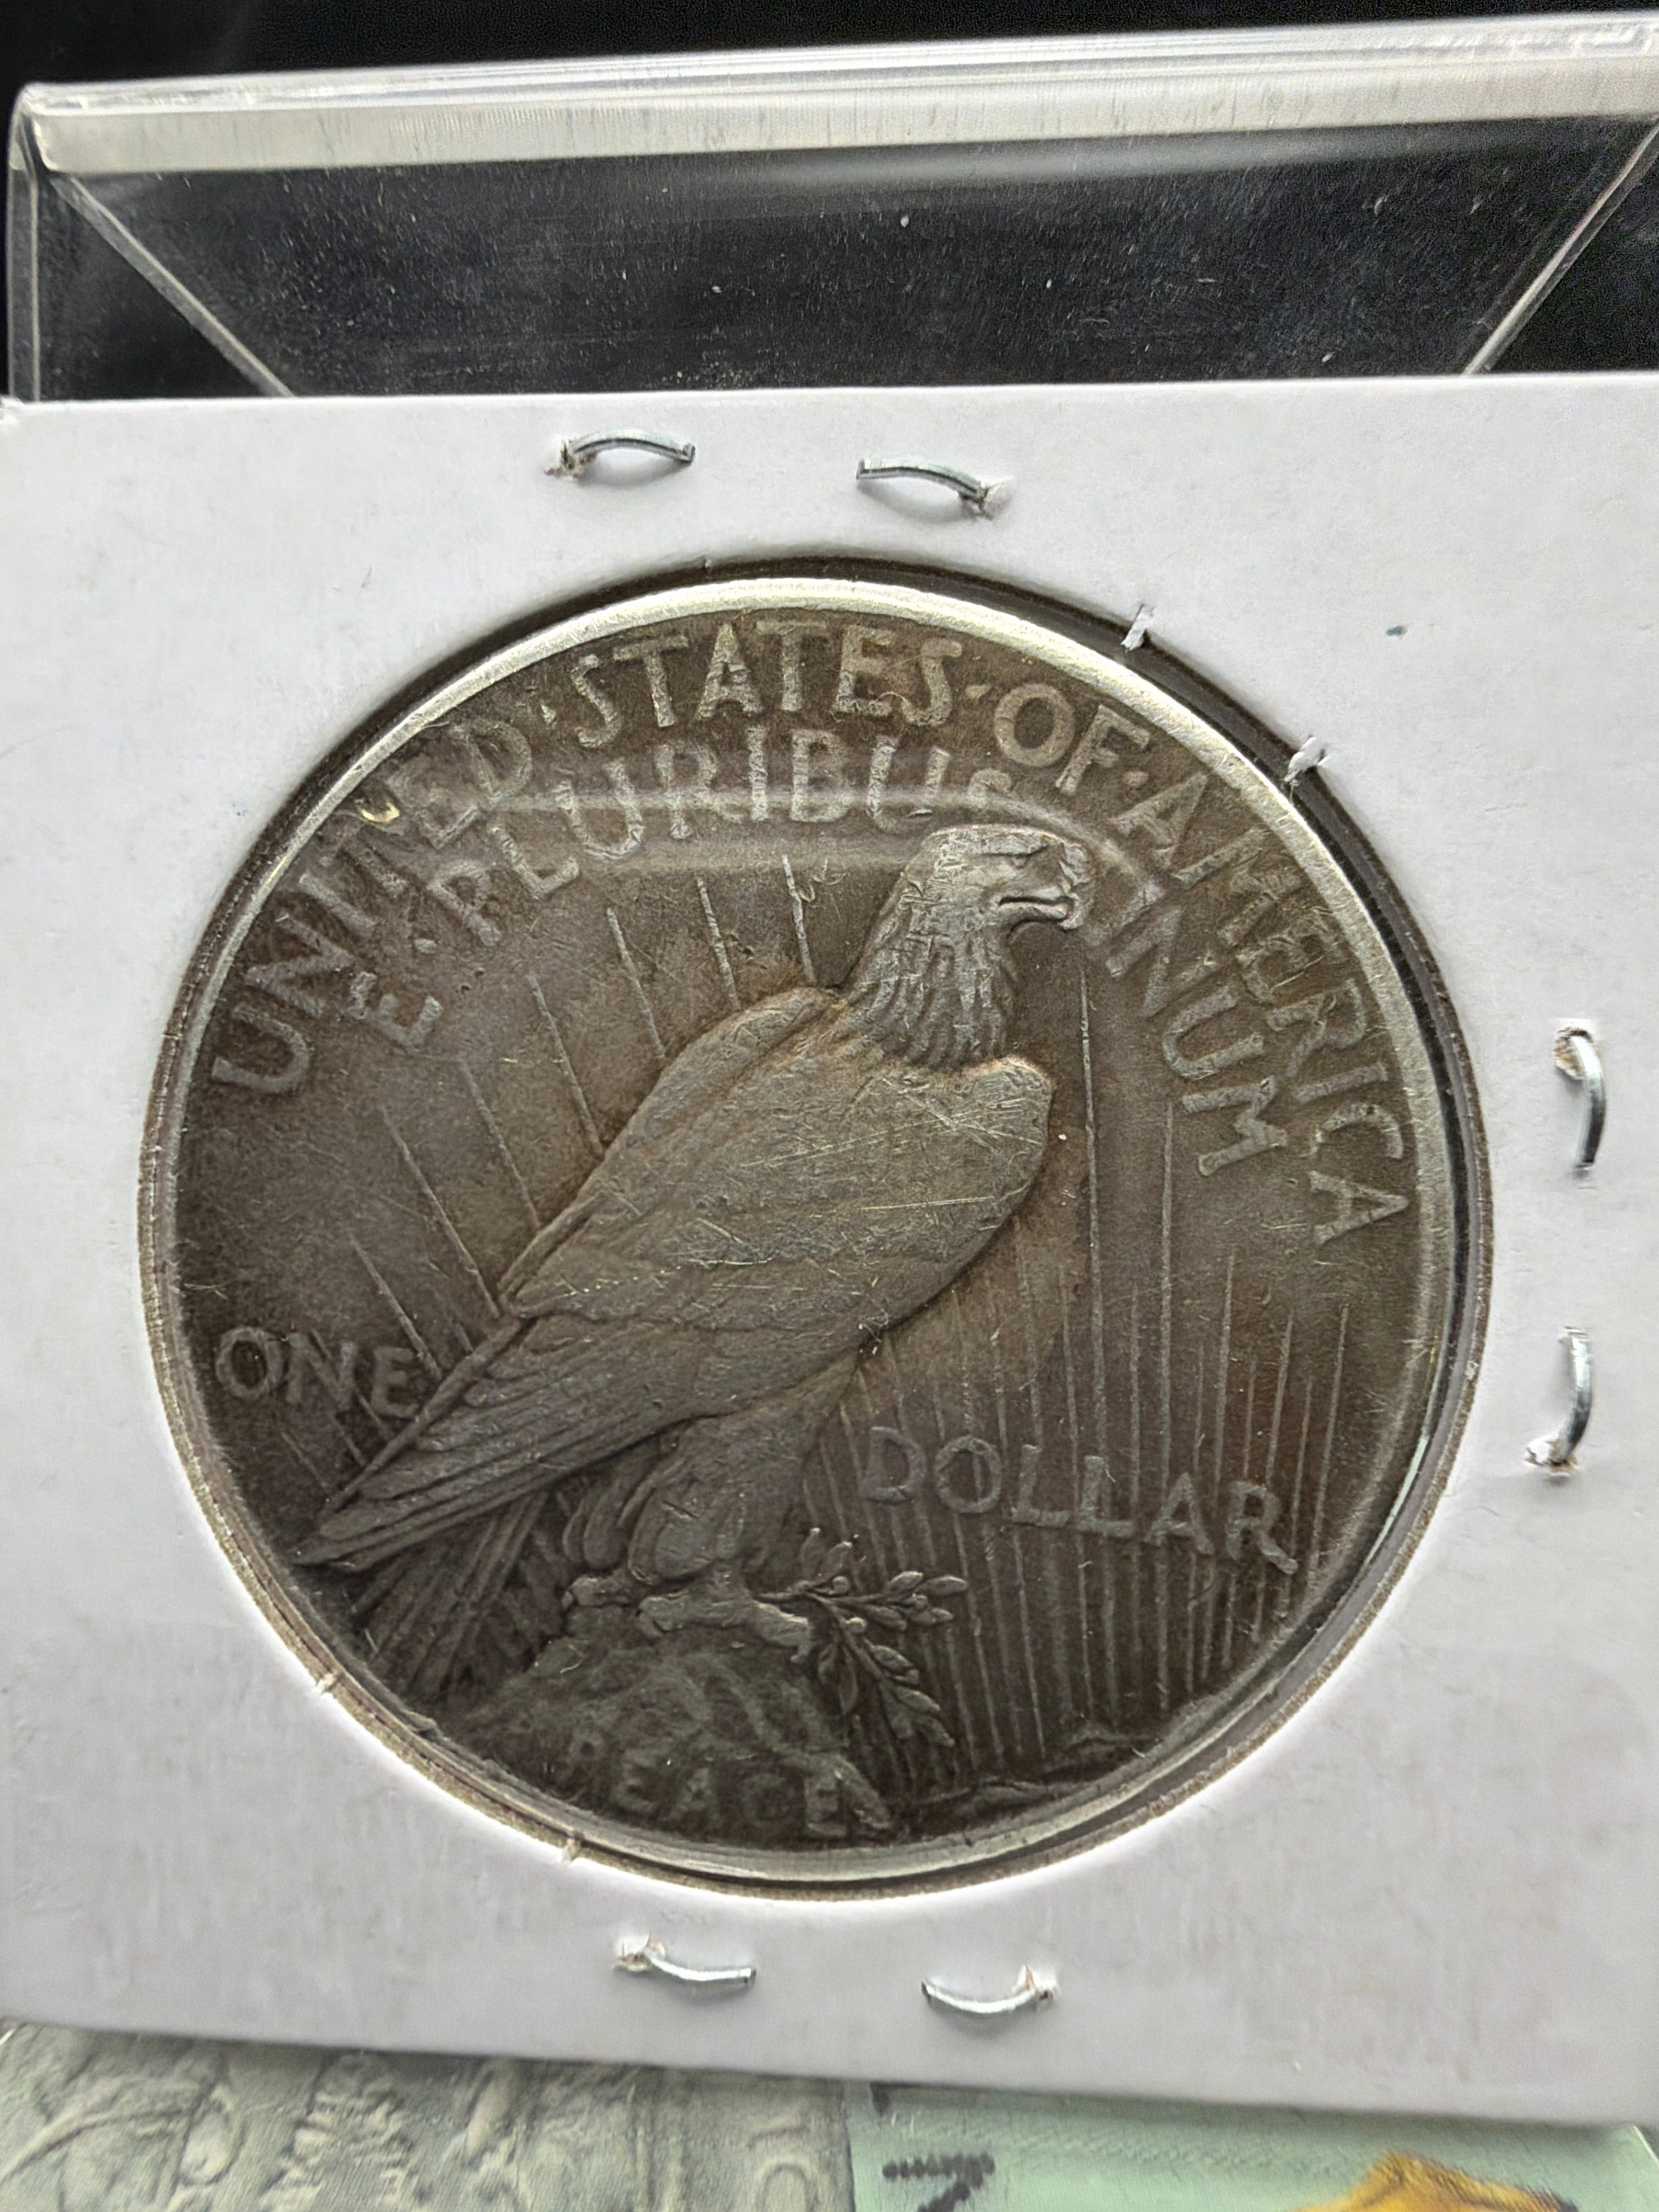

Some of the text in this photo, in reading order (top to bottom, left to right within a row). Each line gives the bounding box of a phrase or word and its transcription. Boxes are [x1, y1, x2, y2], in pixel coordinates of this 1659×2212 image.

[569, 620, 962, 748] STATES
[994, 682, 1150, 795] OF
[1105, 774, 1410, 1245] AMERICA
[216, 1324, 419, 1419] ONE
[860, 1426, 1298, 1575] DOLLAR
